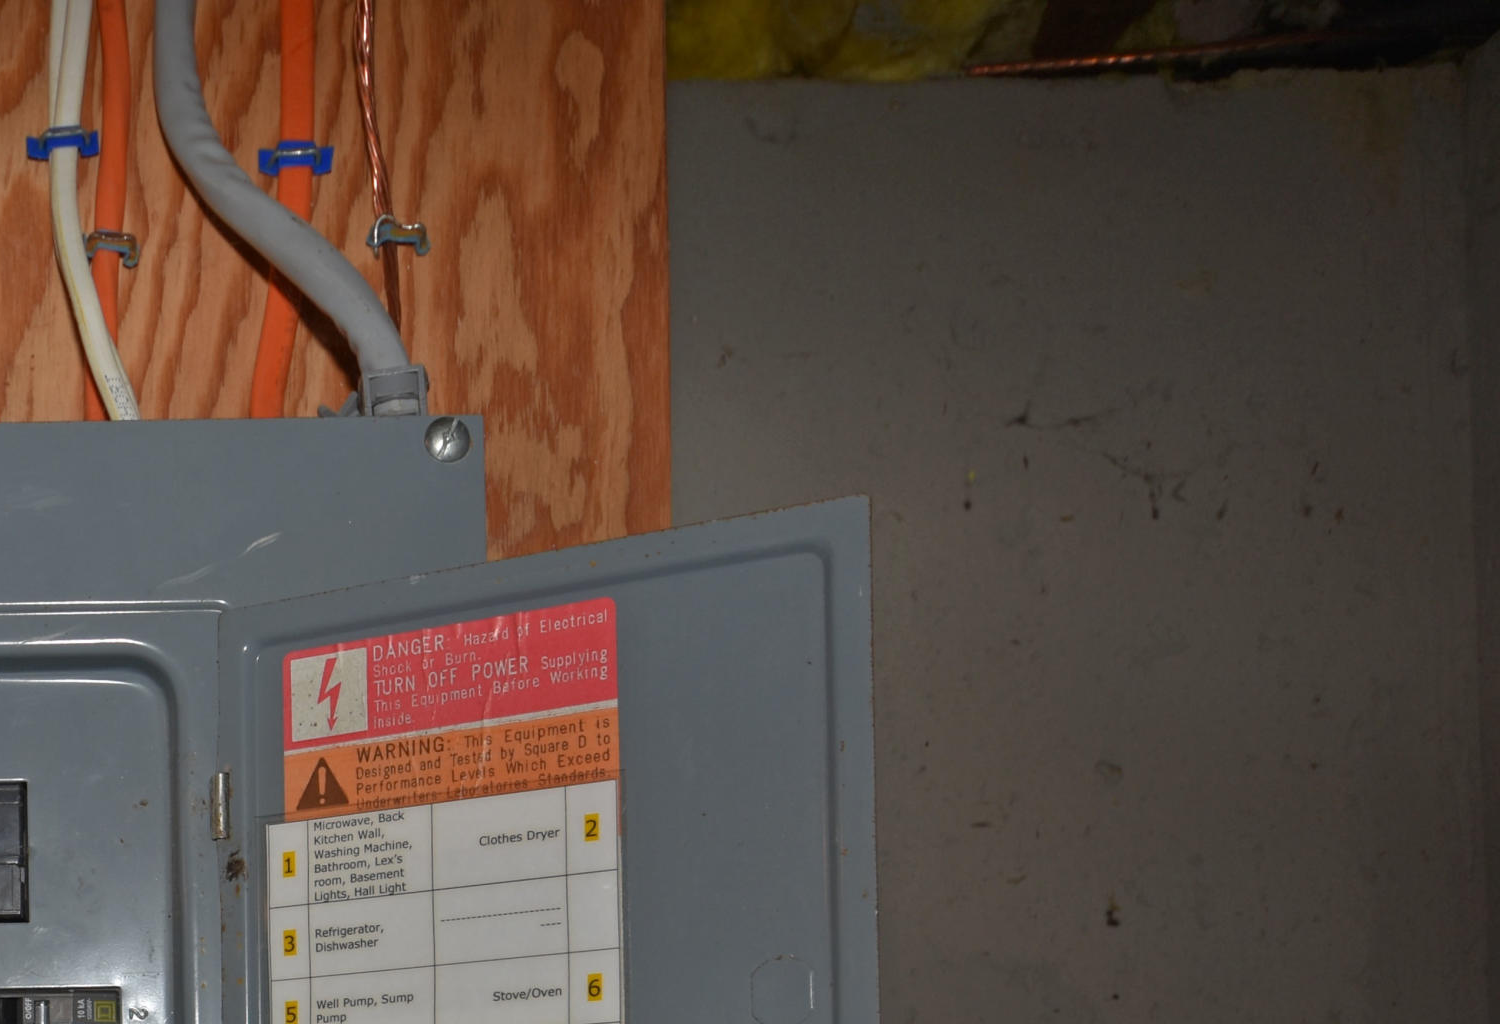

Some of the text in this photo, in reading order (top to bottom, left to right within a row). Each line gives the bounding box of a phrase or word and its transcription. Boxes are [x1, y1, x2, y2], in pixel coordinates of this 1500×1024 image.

[464, 626, 509, 647] Hazard
[518, 623, 529, 637] of
[540, 610, 608, 633] Electrical
[373, 650, 482, 677] Shock or Burn.
[373, 648, 608, 696] TURN OFF POWER Supplying
[374, 665, 608, 712] This Equipment Before Working
[357, 718, 610, 763] WARNING: This Equipment is
[356, 734, 611, 783] Designed and Tested by Square D to
[357, 750, 611, 795] Performance Levels Which Exceed
[314, 810, 405, 831] Microwave, Back
[586, 819, 598, 837] 2
[314, 827, 385, 845] Kitchen Wall,
[479, 827, 560, 848] Clothes Dryer
[314, 839, 412, 860] Washing Machine,
[284, 857, 294, 875] 1
[314, 858, 371, 874] Bathroom,
[314, 868, 405, 888] room, Basement
[314, 881, 407, 903] Lights, Hall Light
[315, 923, 384, 940] Refrigerator,
[284, 935, 295, 953] 3
[315, 937, 379, 953] Dishwasher
[493, 986, 562, 1001] Stove/Oven
[588, 978, 600, 997] 6
[317, 993, 414, 1009] Well Pump, Sump
[286, 1007, 296, 1024] 5
[316, 1012, 347, 1024] Pump
